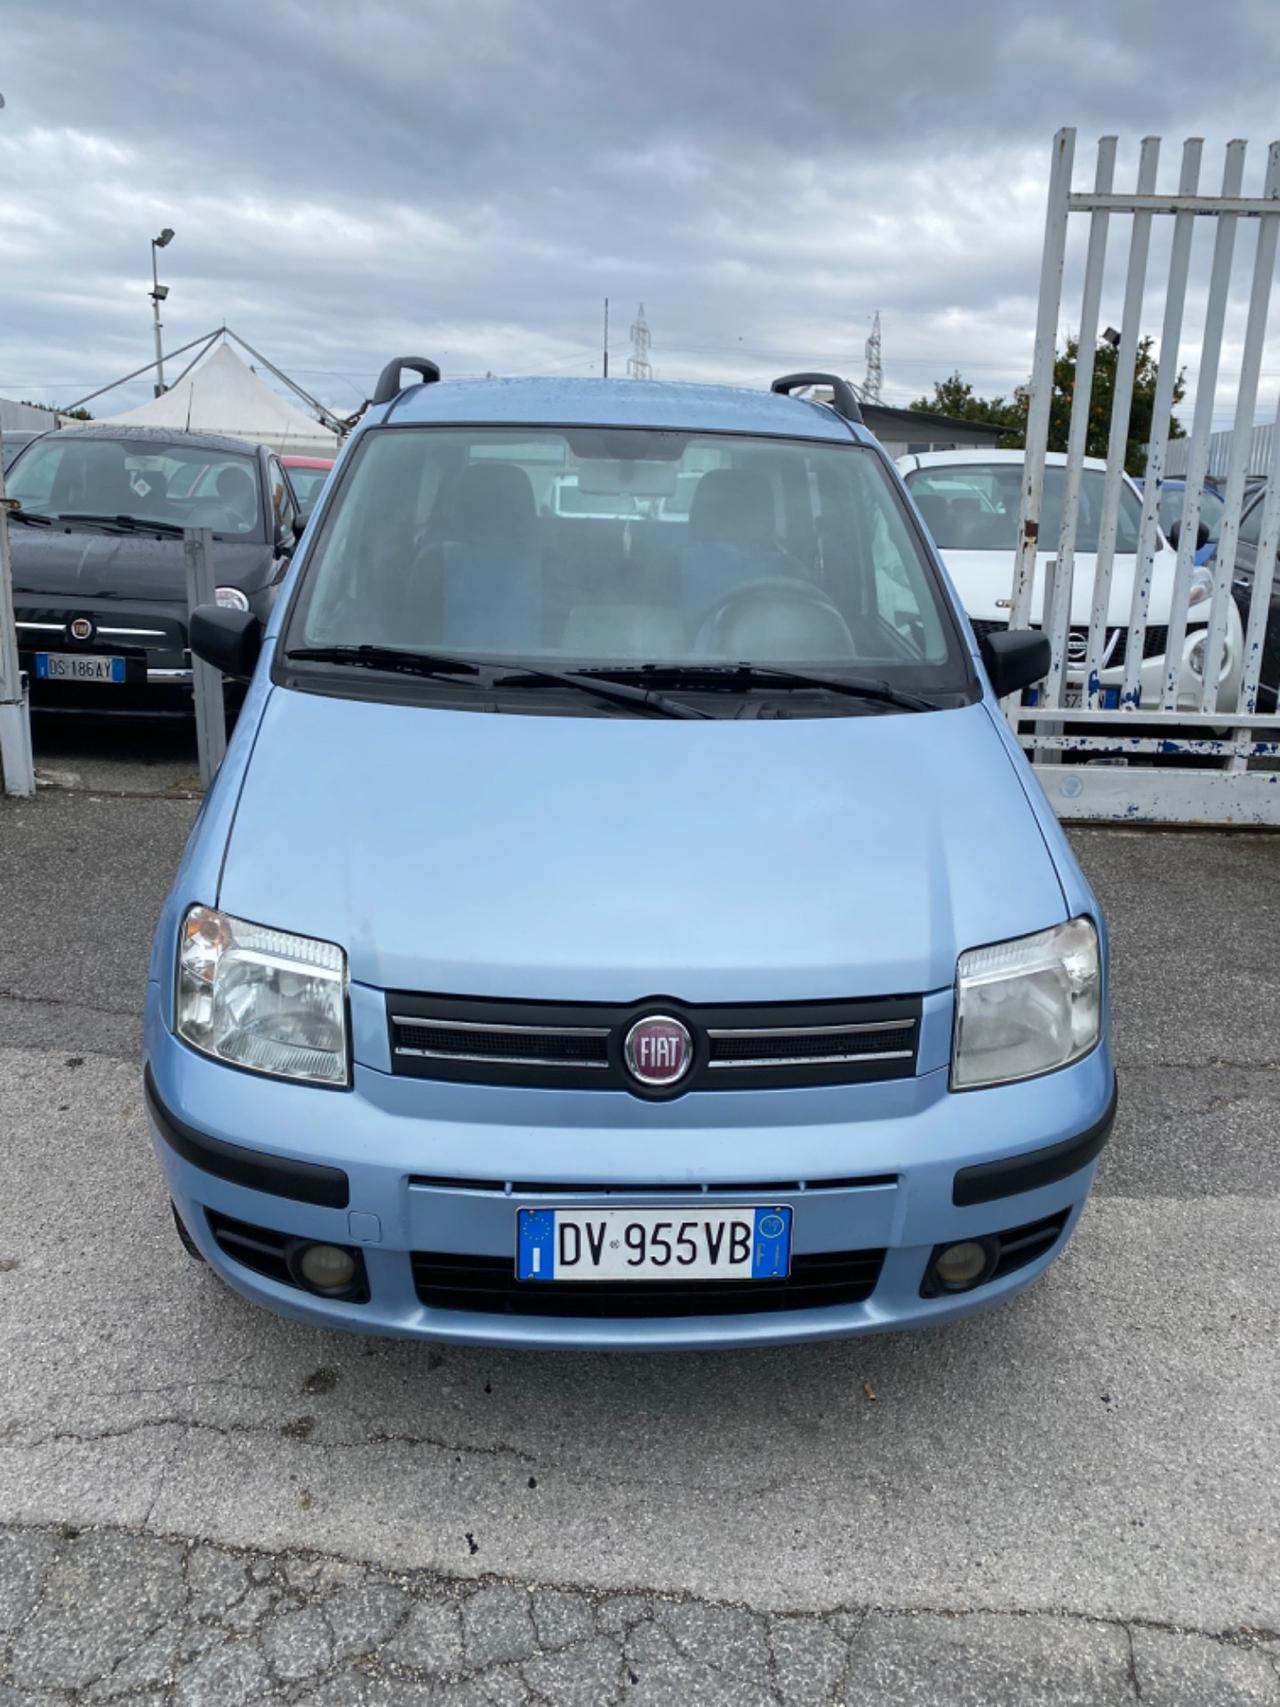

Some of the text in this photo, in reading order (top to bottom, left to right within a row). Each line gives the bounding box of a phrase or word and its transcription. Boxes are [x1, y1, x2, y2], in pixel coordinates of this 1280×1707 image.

[49, 659, 65, 675] DS
[640, 1037, 679, 1067] FIAT
[559, 1221, 751, 1266] DV 955VB
